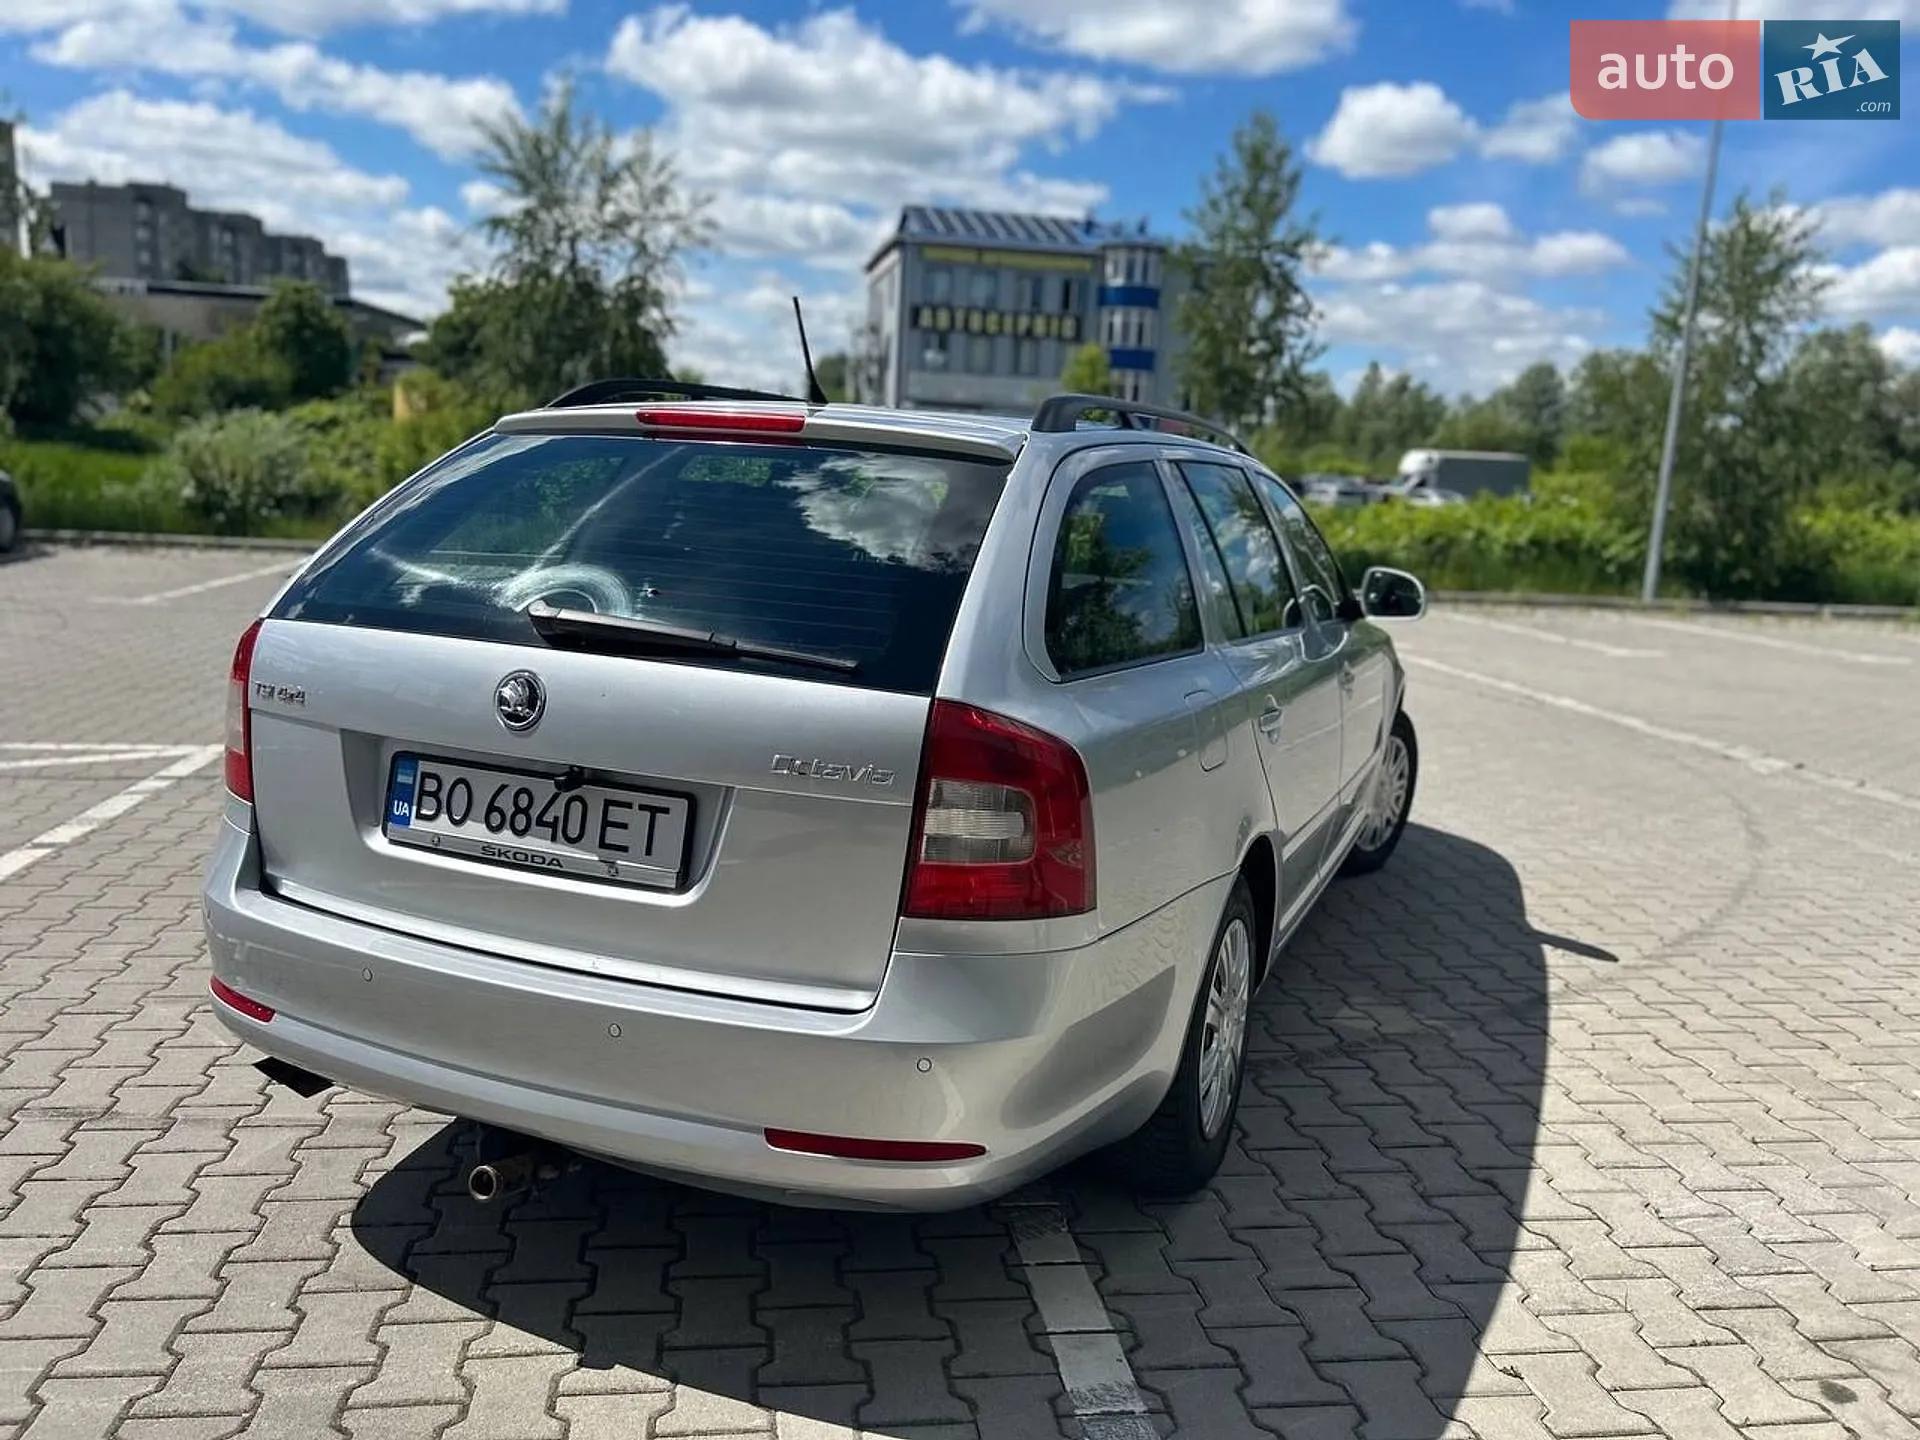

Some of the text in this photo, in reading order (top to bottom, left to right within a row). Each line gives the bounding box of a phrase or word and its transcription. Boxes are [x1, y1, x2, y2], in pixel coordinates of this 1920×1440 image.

[770, 754, 896, 785] Octavia
[393, 800, 409, 816] UA
[415, 771, 670, 857] BO 6840 ET
